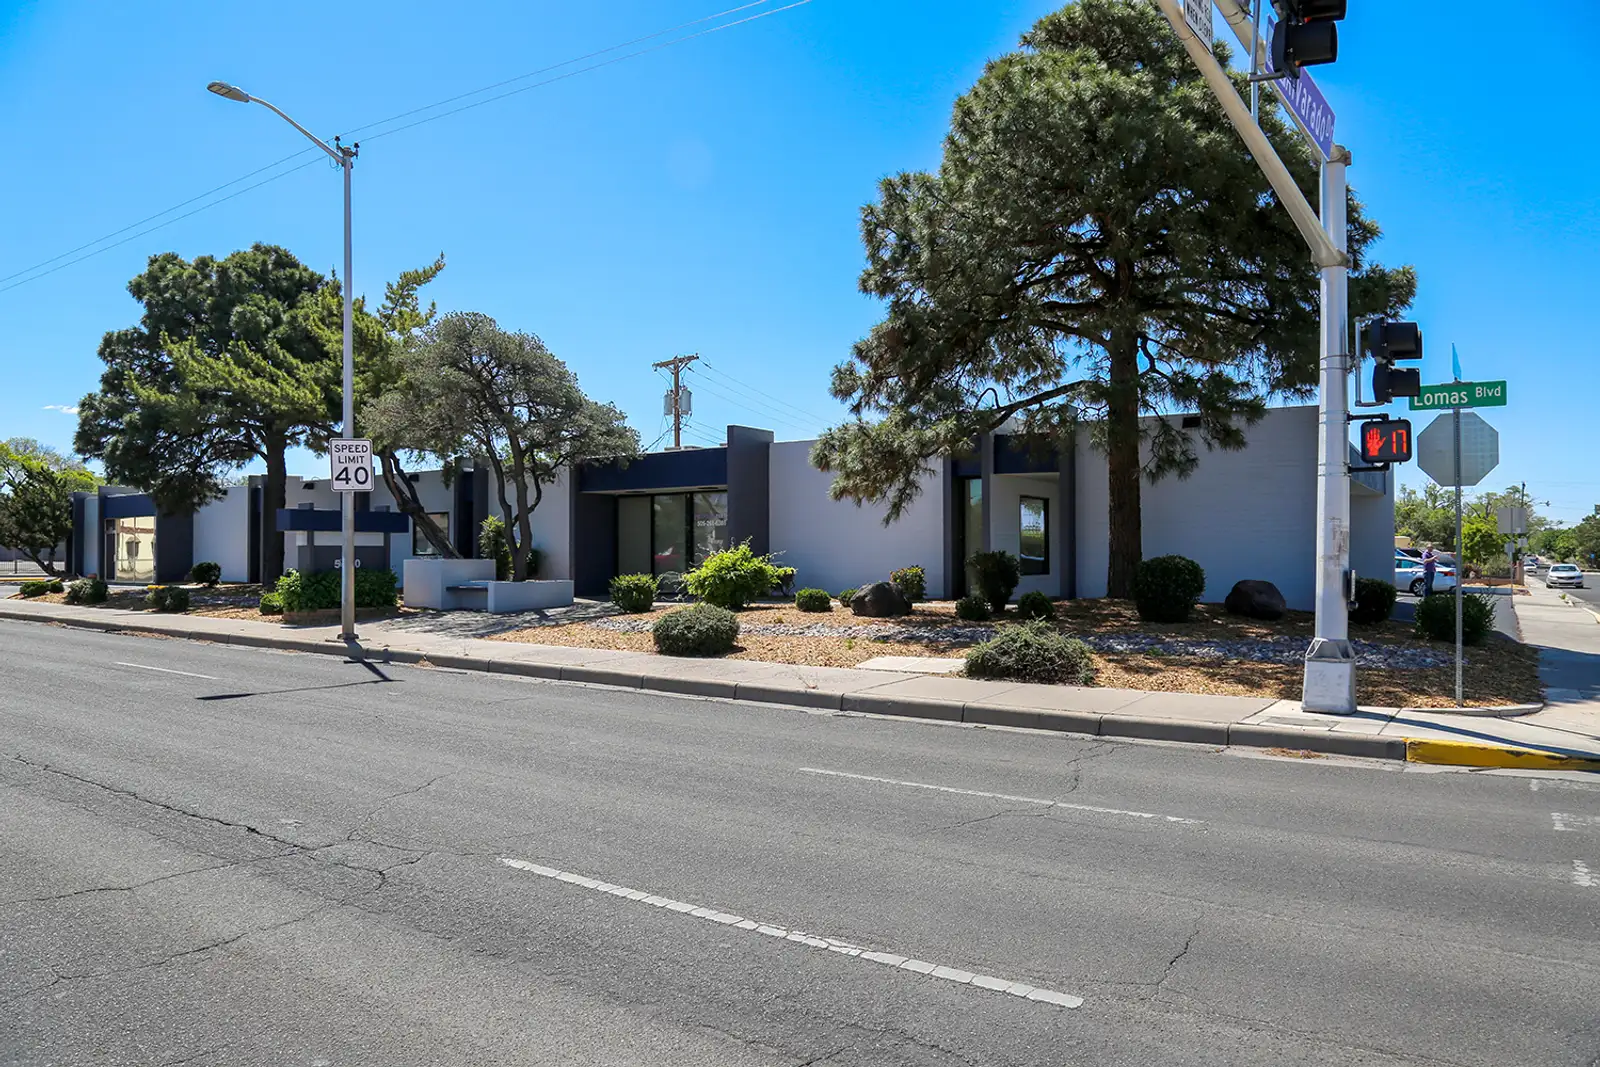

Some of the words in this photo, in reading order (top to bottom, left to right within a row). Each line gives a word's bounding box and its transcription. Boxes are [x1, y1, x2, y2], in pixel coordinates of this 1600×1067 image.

[1414, 391, 1468, 406] Lomas
[1475, 386, 1501, 397] Blvd
[334, 444, 369, 453] SPEED
[1391, 429, 1407, 454] 17
[338, 455, 365, 464] LIMIT
[334, 466, 369, 485] 40
[334, 559, 361, 568] 50
